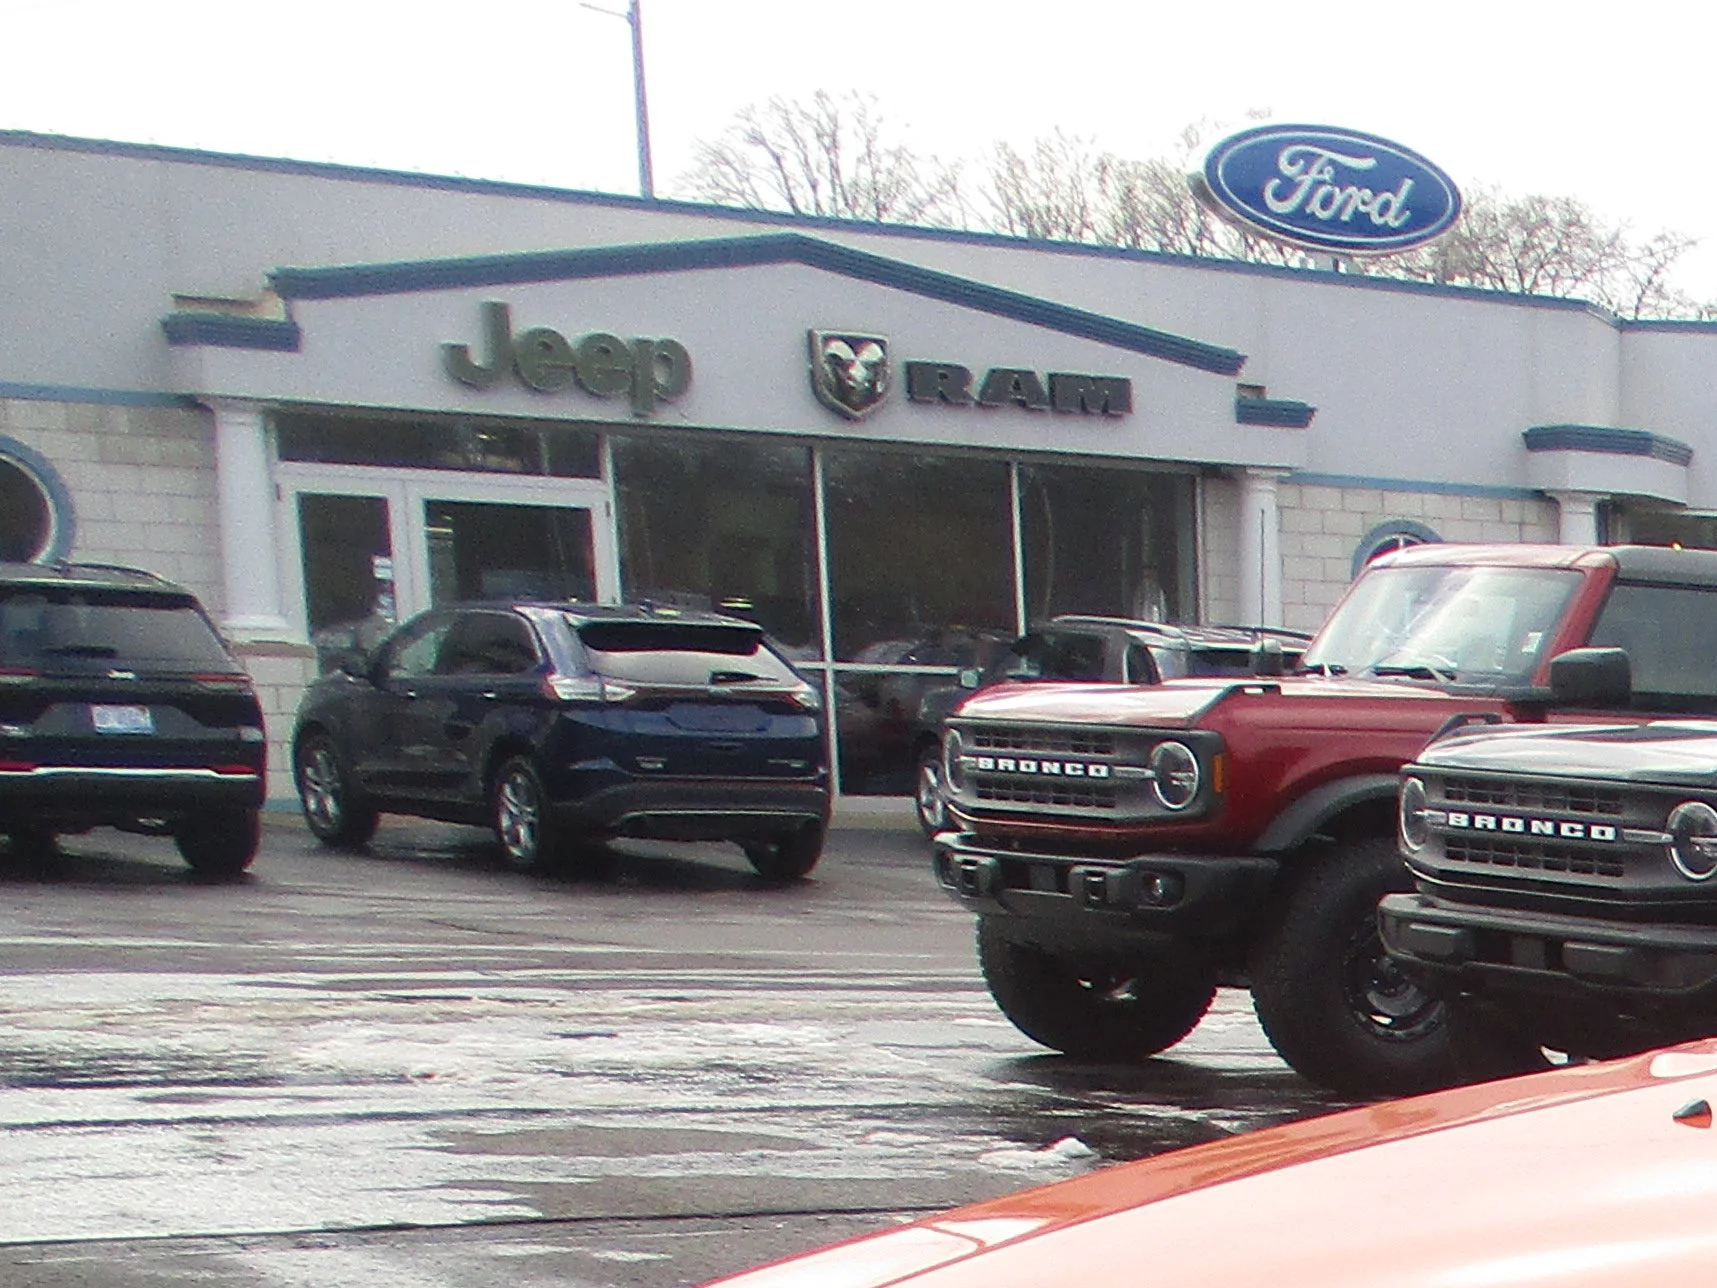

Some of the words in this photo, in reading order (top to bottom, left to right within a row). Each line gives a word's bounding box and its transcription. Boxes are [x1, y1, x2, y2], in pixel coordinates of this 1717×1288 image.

[1264, 144, 1415, 228] Ford
[440, 299, 693, 417] Jeep
[905, 360, 1134, 417] RAM
[978, 756, 1109, 778] BRONCO
[1448, 811, 1616, 841] BRONCO
